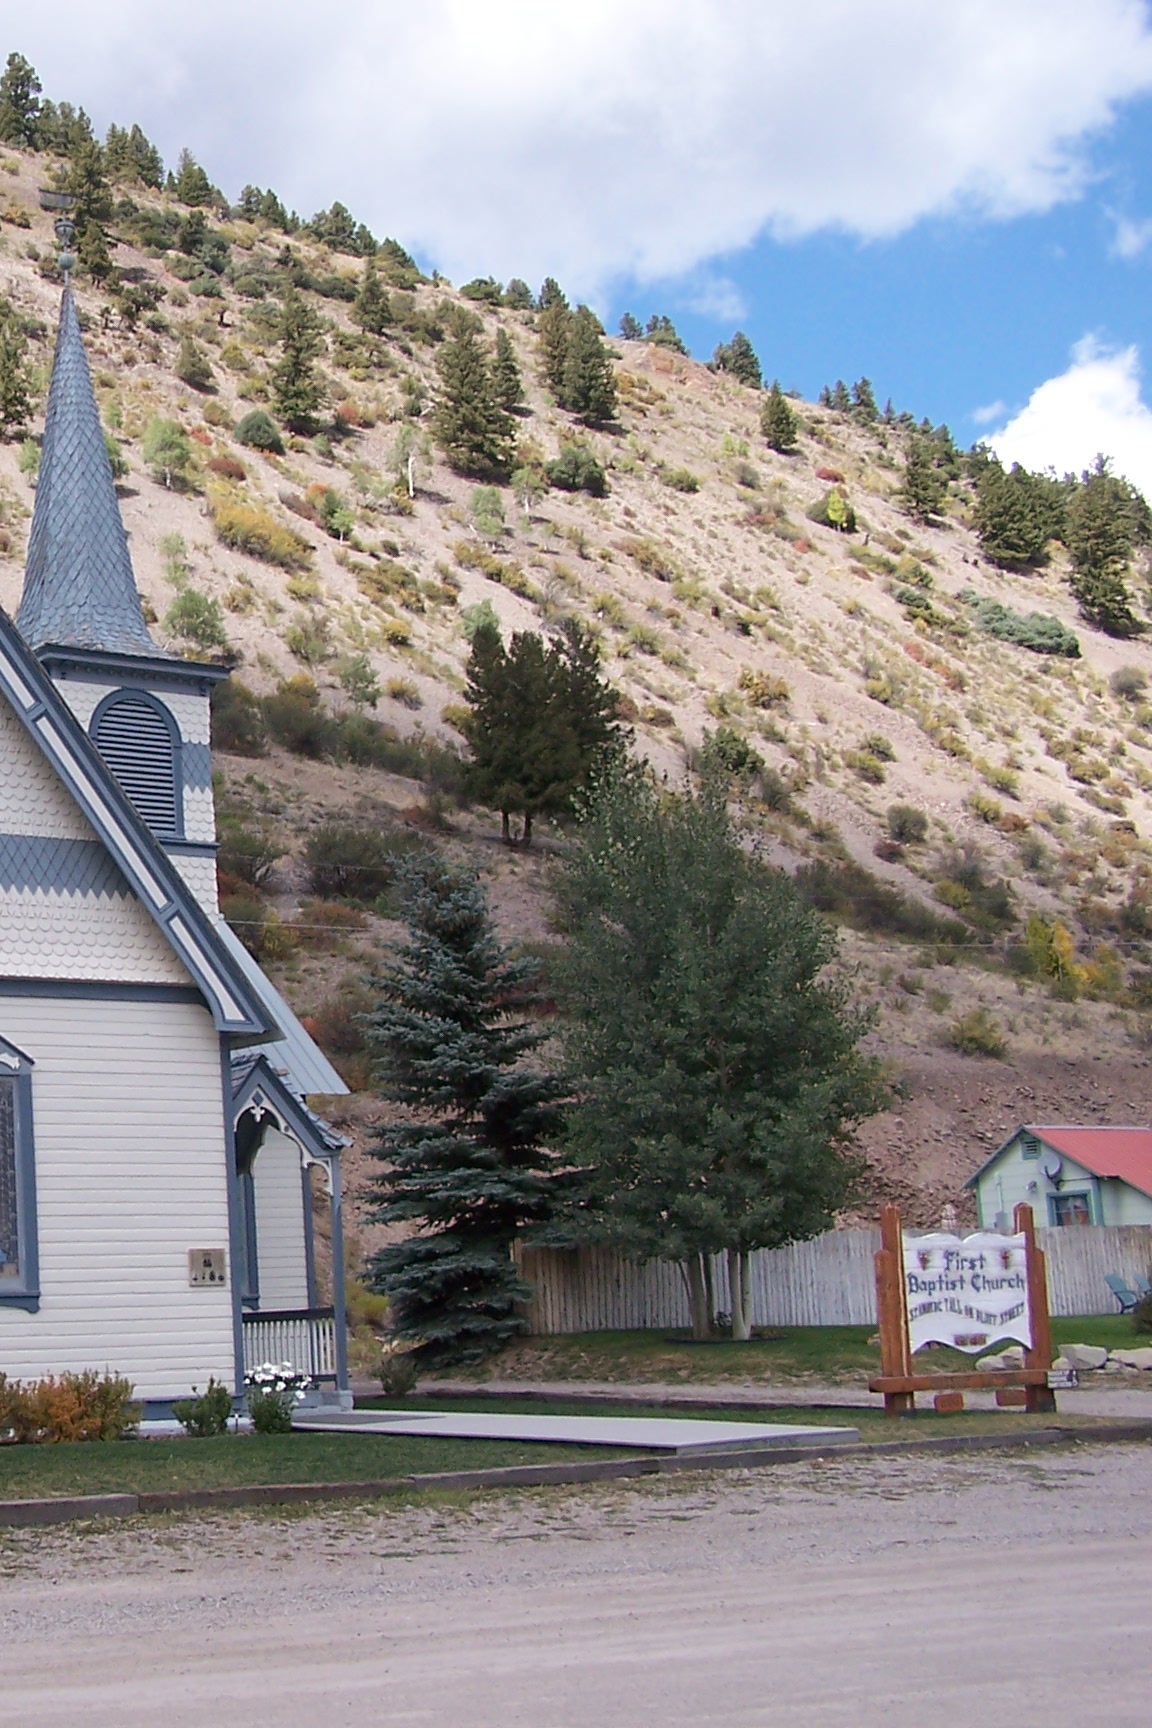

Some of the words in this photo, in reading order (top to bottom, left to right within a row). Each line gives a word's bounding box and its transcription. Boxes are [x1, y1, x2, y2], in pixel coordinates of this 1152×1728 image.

[943, 1250, 986, 1271] First
[907, 1273, 966, 1296] Baptist
[971, 1273, 1026, 1293] Church
